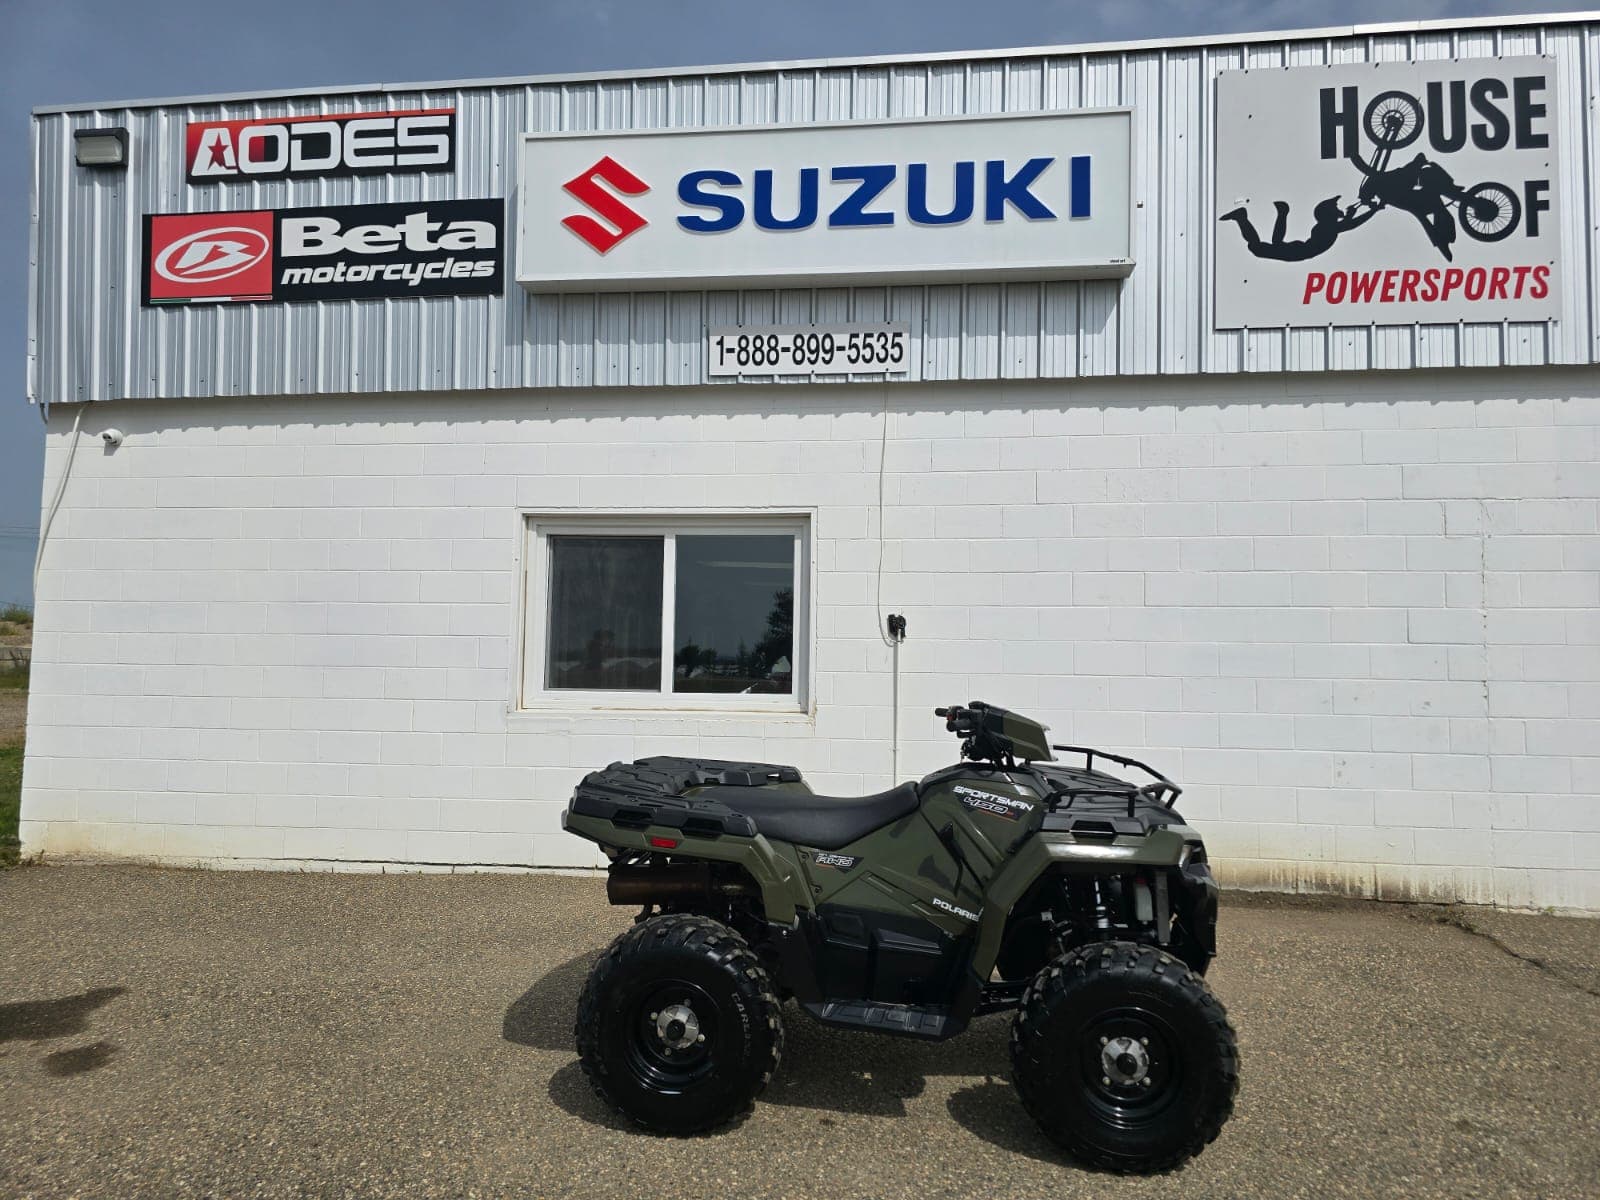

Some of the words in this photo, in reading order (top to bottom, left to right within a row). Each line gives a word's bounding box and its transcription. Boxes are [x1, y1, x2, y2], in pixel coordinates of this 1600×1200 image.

[1319, 75, 1549, 160] HOUSE
[191, 116, 449, 176] AODES
[677, 155, 1091, 234] SUZUKI
[1458, 180, 1550, 242] OF
[280, 212, 497, 257] Beta
[280, 257, 496, 286] motorcycles
[1303, 266, 1551, 305] POWERSPORTS
[716, 332, 904, 366] 1-888-899-5535
[953, 785, 1035, 812] SPORTSMAN
[932, 897, 980, 922] POLARIS
